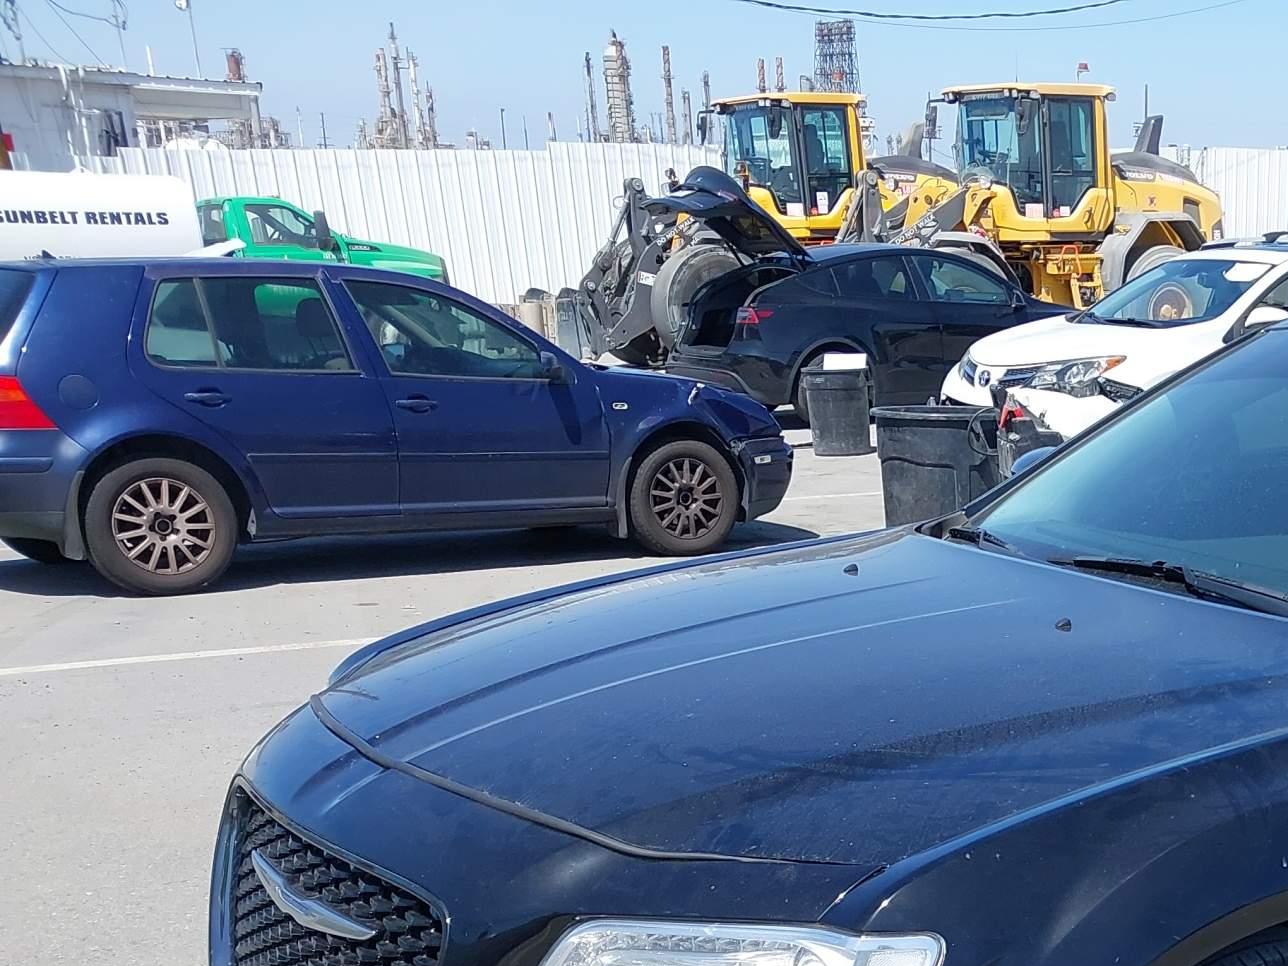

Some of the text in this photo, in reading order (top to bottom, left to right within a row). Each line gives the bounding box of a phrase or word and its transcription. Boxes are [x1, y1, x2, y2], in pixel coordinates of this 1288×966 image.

[85, 211, 169, 225] RENTALS
[656, 215, 695, 246] DO NOT WALK
[895, 214, 935, 244] DO NOT WALK
